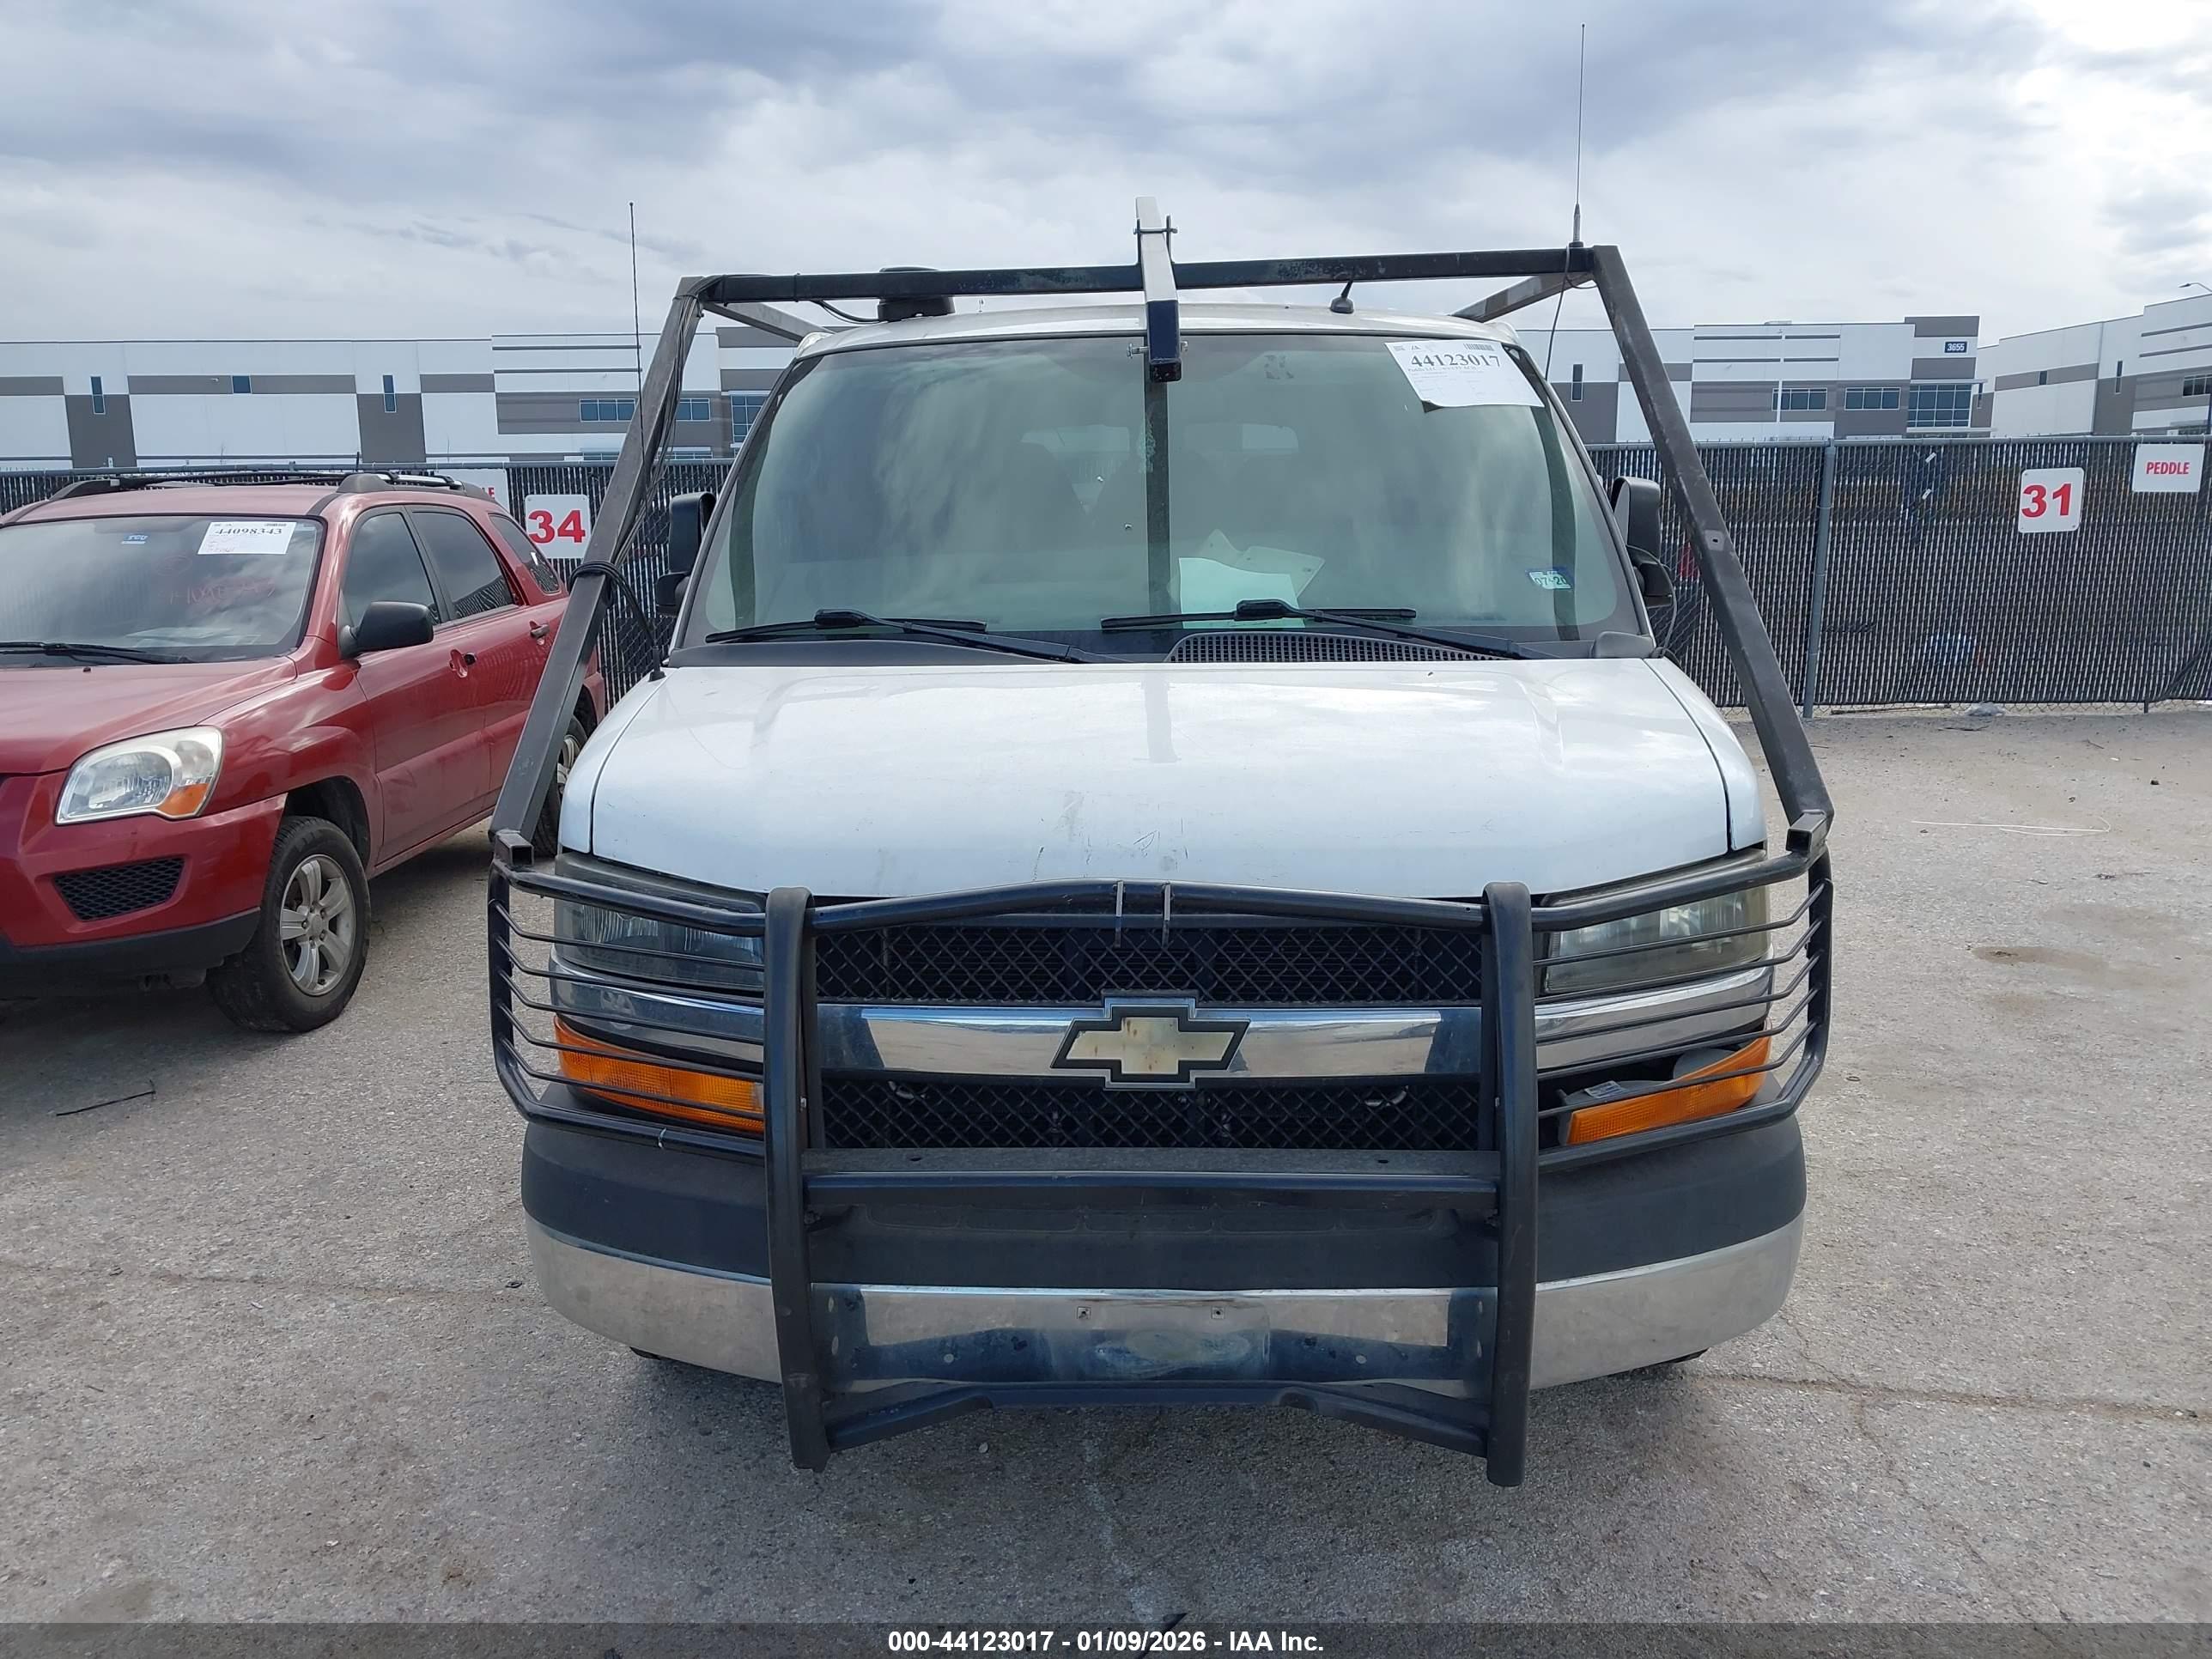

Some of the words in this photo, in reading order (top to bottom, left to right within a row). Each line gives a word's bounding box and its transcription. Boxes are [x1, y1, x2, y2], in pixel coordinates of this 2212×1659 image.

[1948, 343, 1965, 351] 3655
[1411, 353, 1500, 368] 44123017
[2146, 461, 2191, 475] PEDDLE
[2021, 483, 2072, 518] 31
[528, 509, 586, 544] 34
